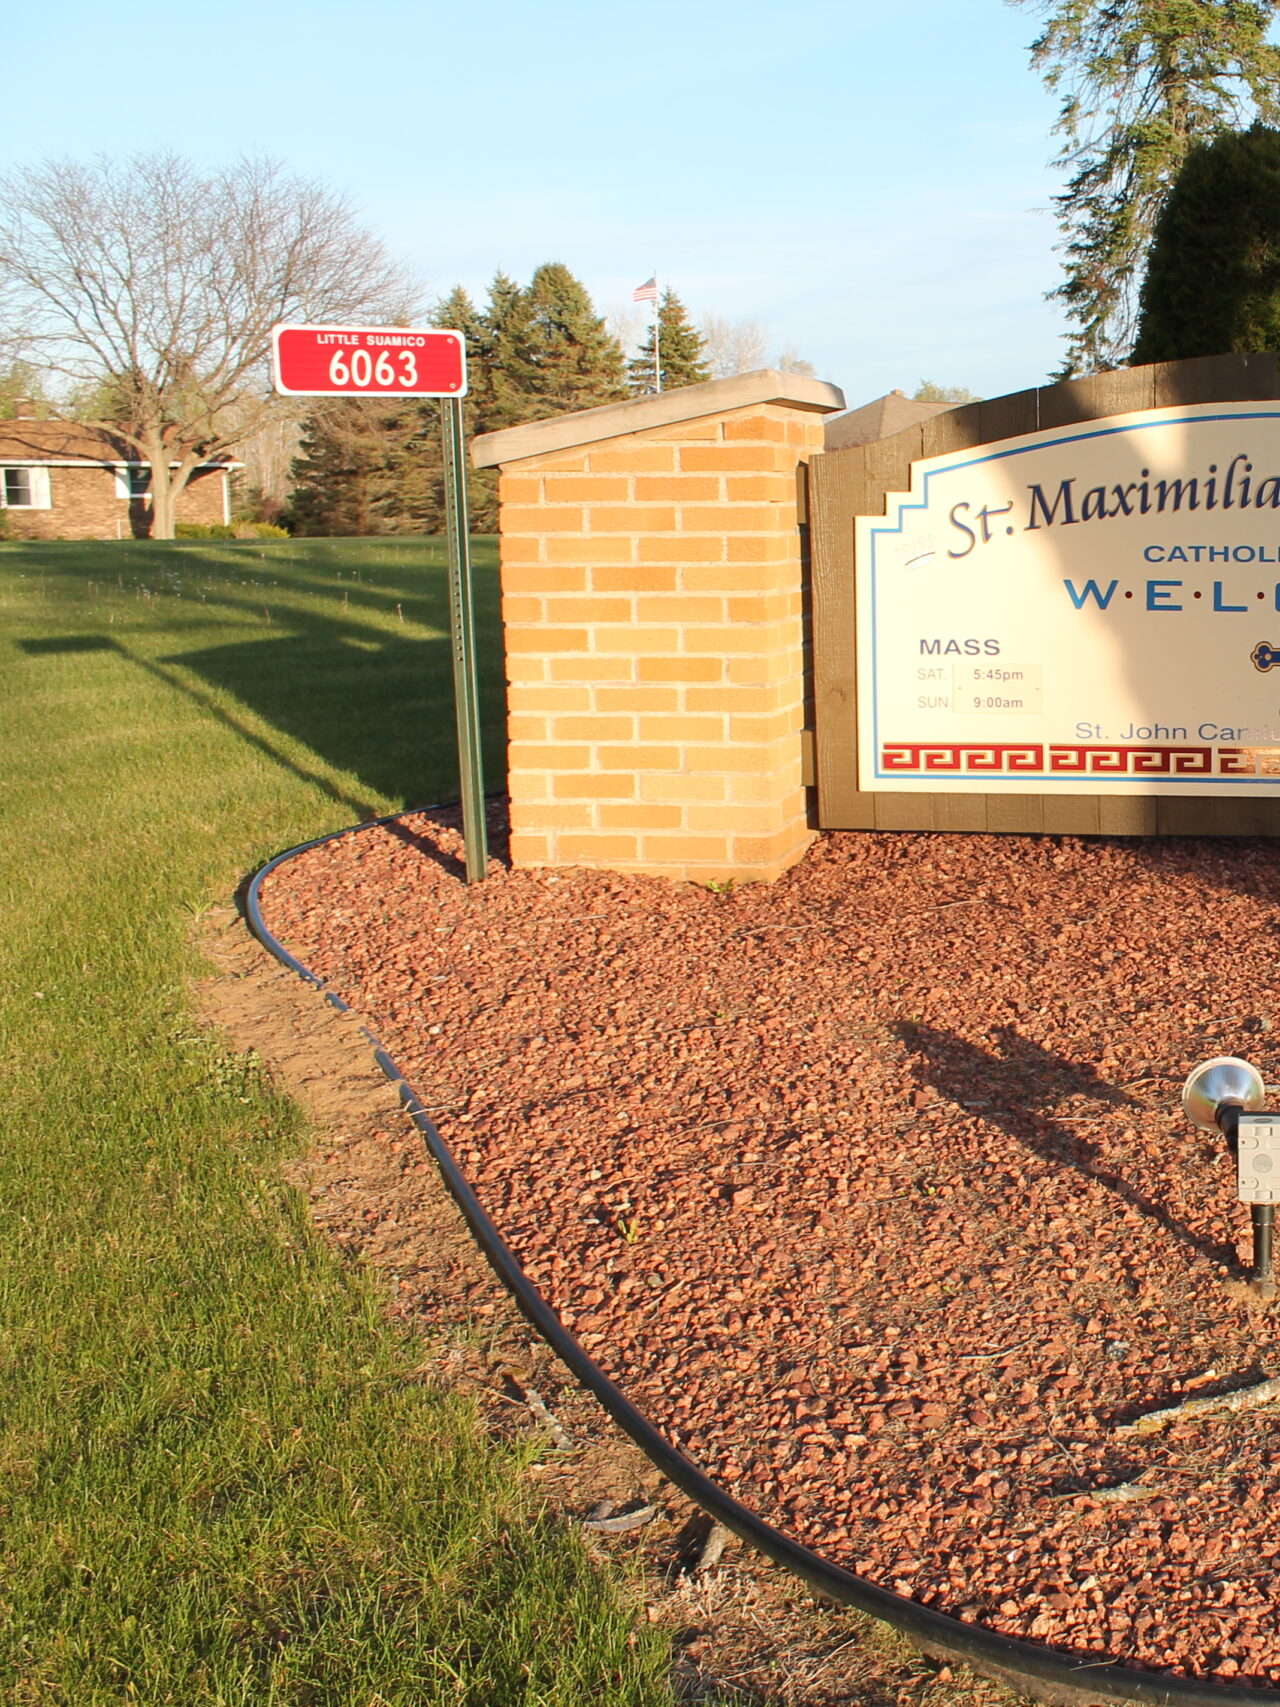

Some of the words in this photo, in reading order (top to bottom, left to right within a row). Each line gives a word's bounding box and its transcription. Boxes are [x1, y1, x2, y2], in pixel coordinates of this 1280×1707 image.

[317, 334, 360, 345] LITTLE
[366, 335, 426, 347] SUAMICO
[329, 349, 418, 387] 6063
[947, 500, 1014, 559] St.
[919, 639, 1001, 656] MASS
[973, 669, 1024, 682] 5:45pm
[973, 697, 1024, 708] 9:00am
[1075, 723, 1109, 739] St.
[1120, 723, 1187, 740] John
